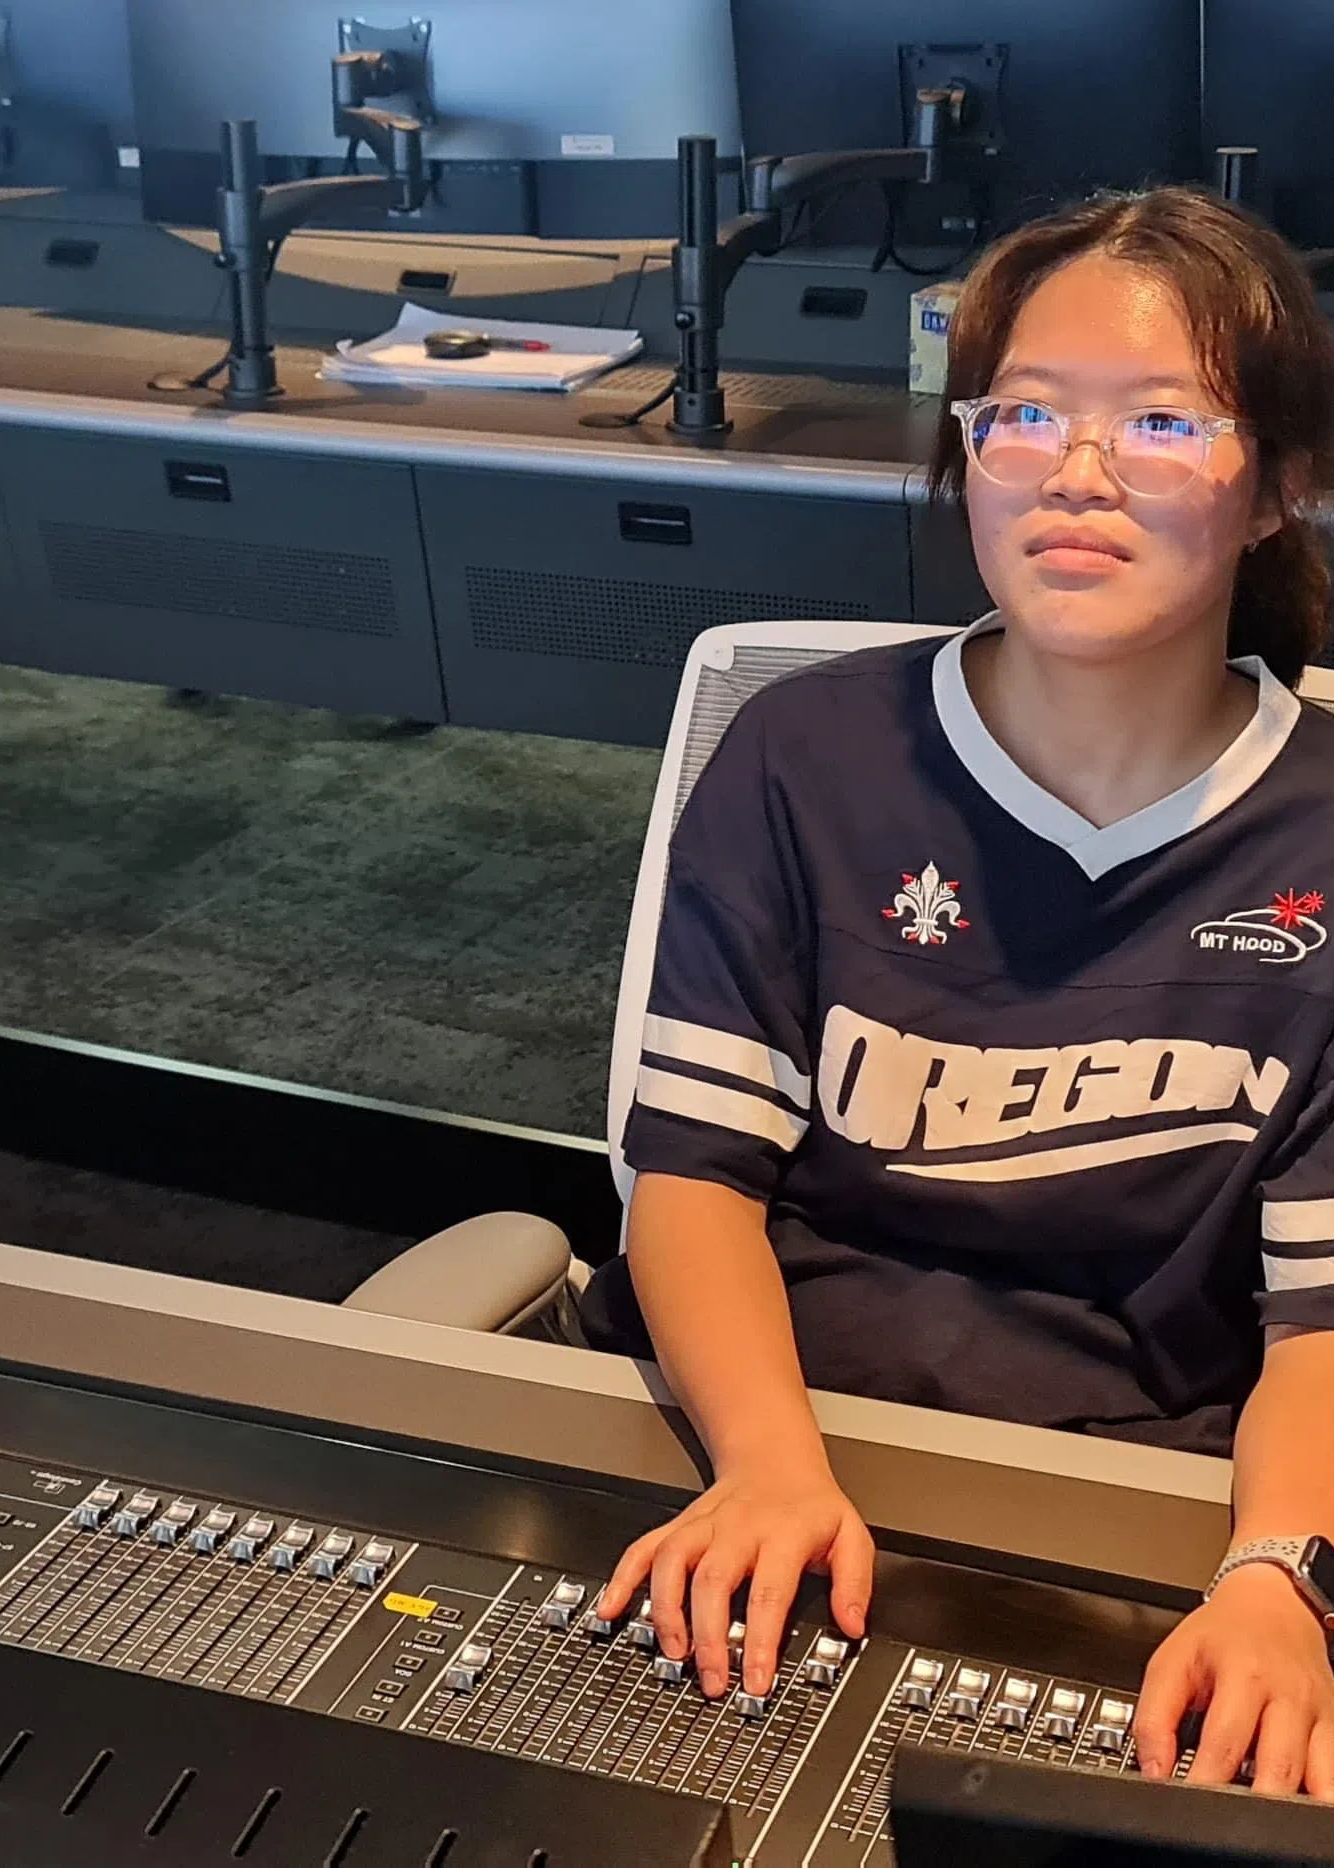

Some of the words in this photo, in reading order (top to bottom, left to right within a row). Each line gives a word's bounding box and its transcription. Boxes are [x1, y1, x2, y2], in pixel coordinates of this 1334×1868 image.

[1199, 932, 1229, 950] MT
[1233, 935, 1286, 953] HOOD
[818, 1004, 1290, 1151] OREGON
